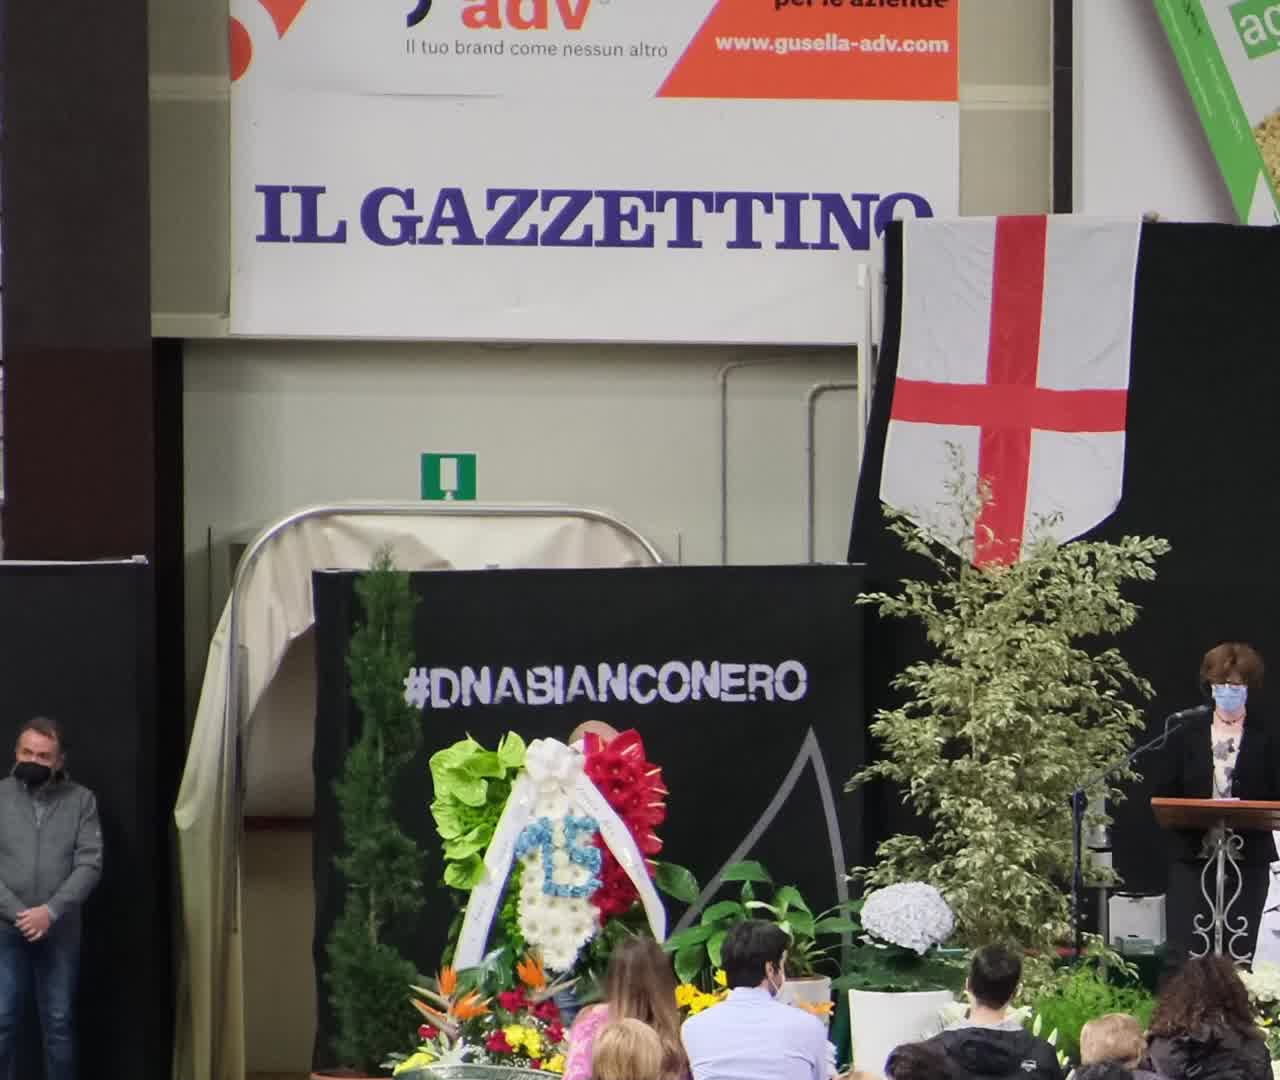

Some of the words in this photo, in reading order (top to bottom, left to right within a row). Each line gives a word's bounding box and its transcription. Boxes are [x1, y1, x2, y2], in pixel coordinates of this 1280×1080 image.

[406, 40, 415, 55] Il
[421, 41, 449, 55] tuo
[455, 39, 504, 56] brand
[510, 43, 557, 56] come
[563, 43, 623, 57] nessun
[629, 41, 668, 58] altro
[715, 33, 949, 54] www.gusella-adv.com
[255, 185, 347, 243] IL
[403, 660, 808, 709] #DNABIANCONERO
